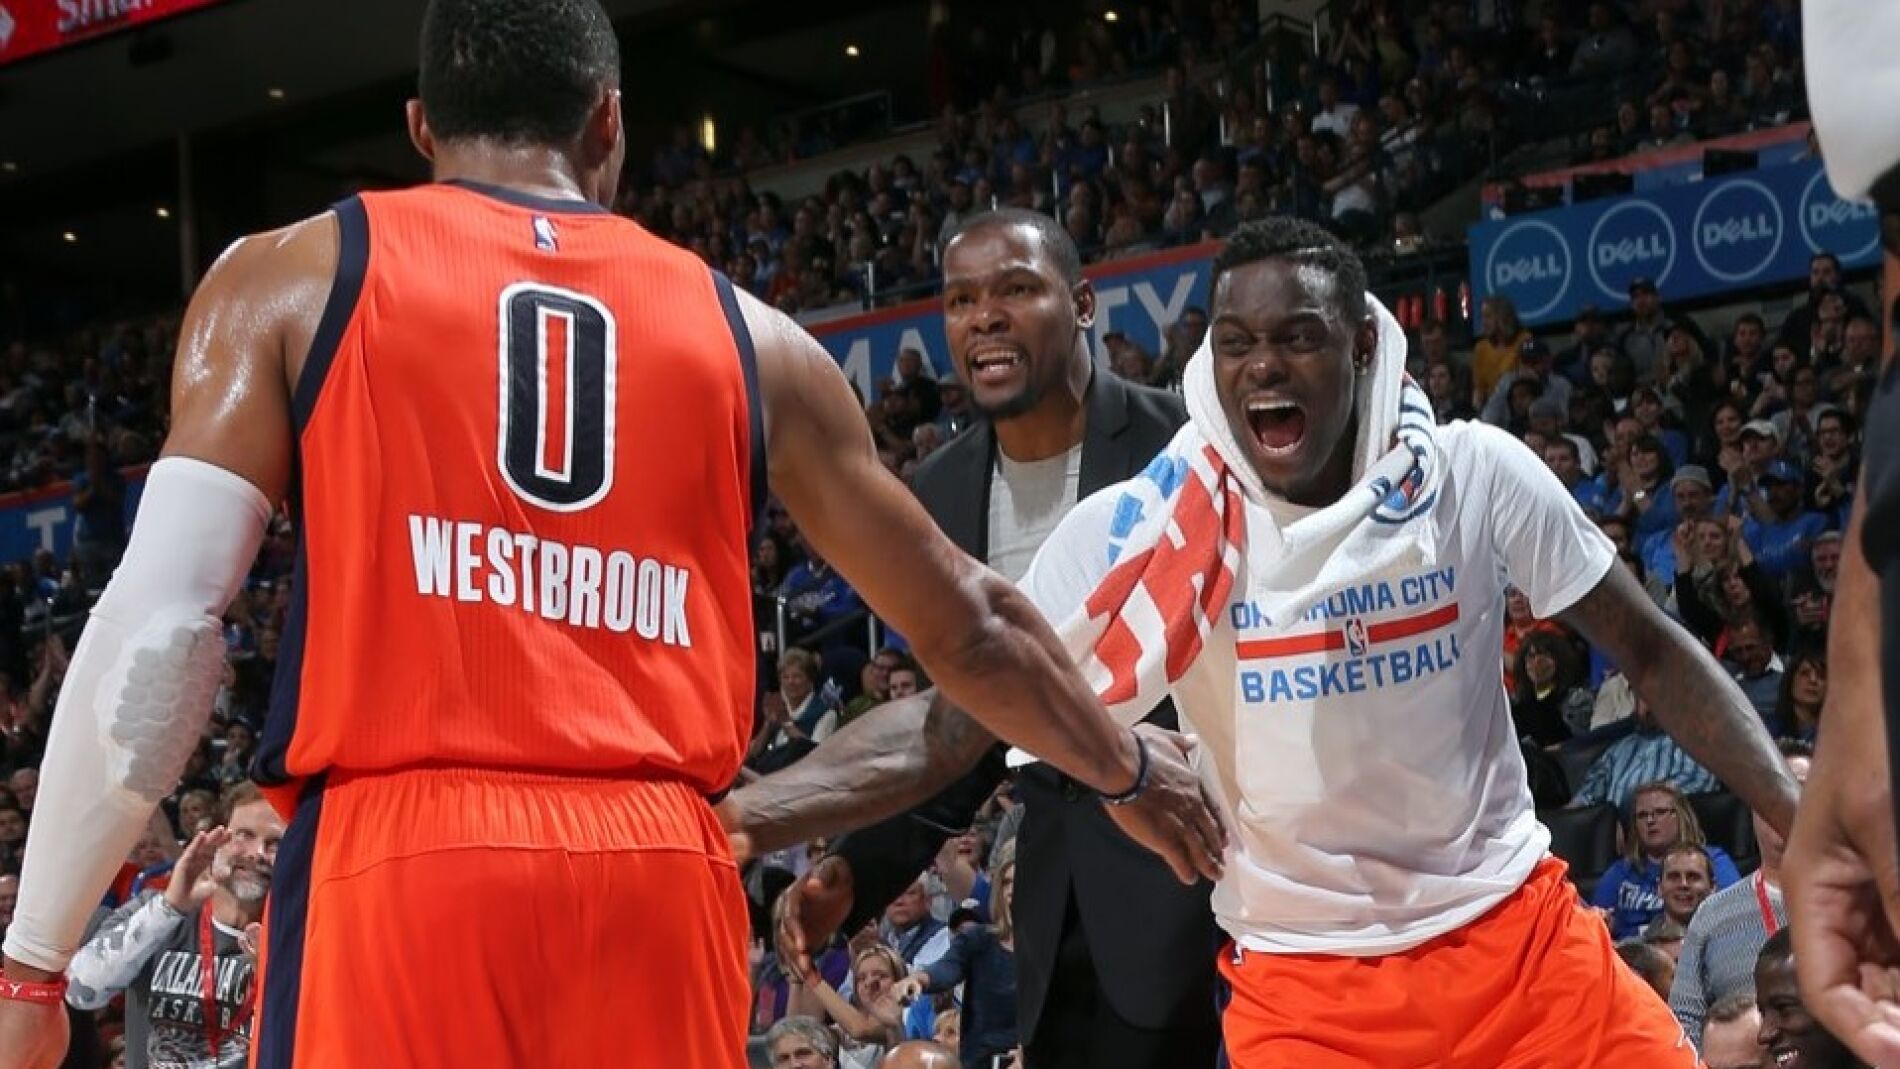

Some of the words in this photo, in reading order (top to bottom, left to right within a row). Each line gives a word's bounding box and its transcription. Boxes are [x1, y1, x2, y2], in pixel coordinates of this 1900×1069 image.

[1703, 214, 1773, 246] DELL
[1598, 234, 1666, 267] DELL
[1494, 255, 1562, 285] DELL
[498, 281, 617, 513] 0
[409, 515, 692, 648] WESTBROOK
